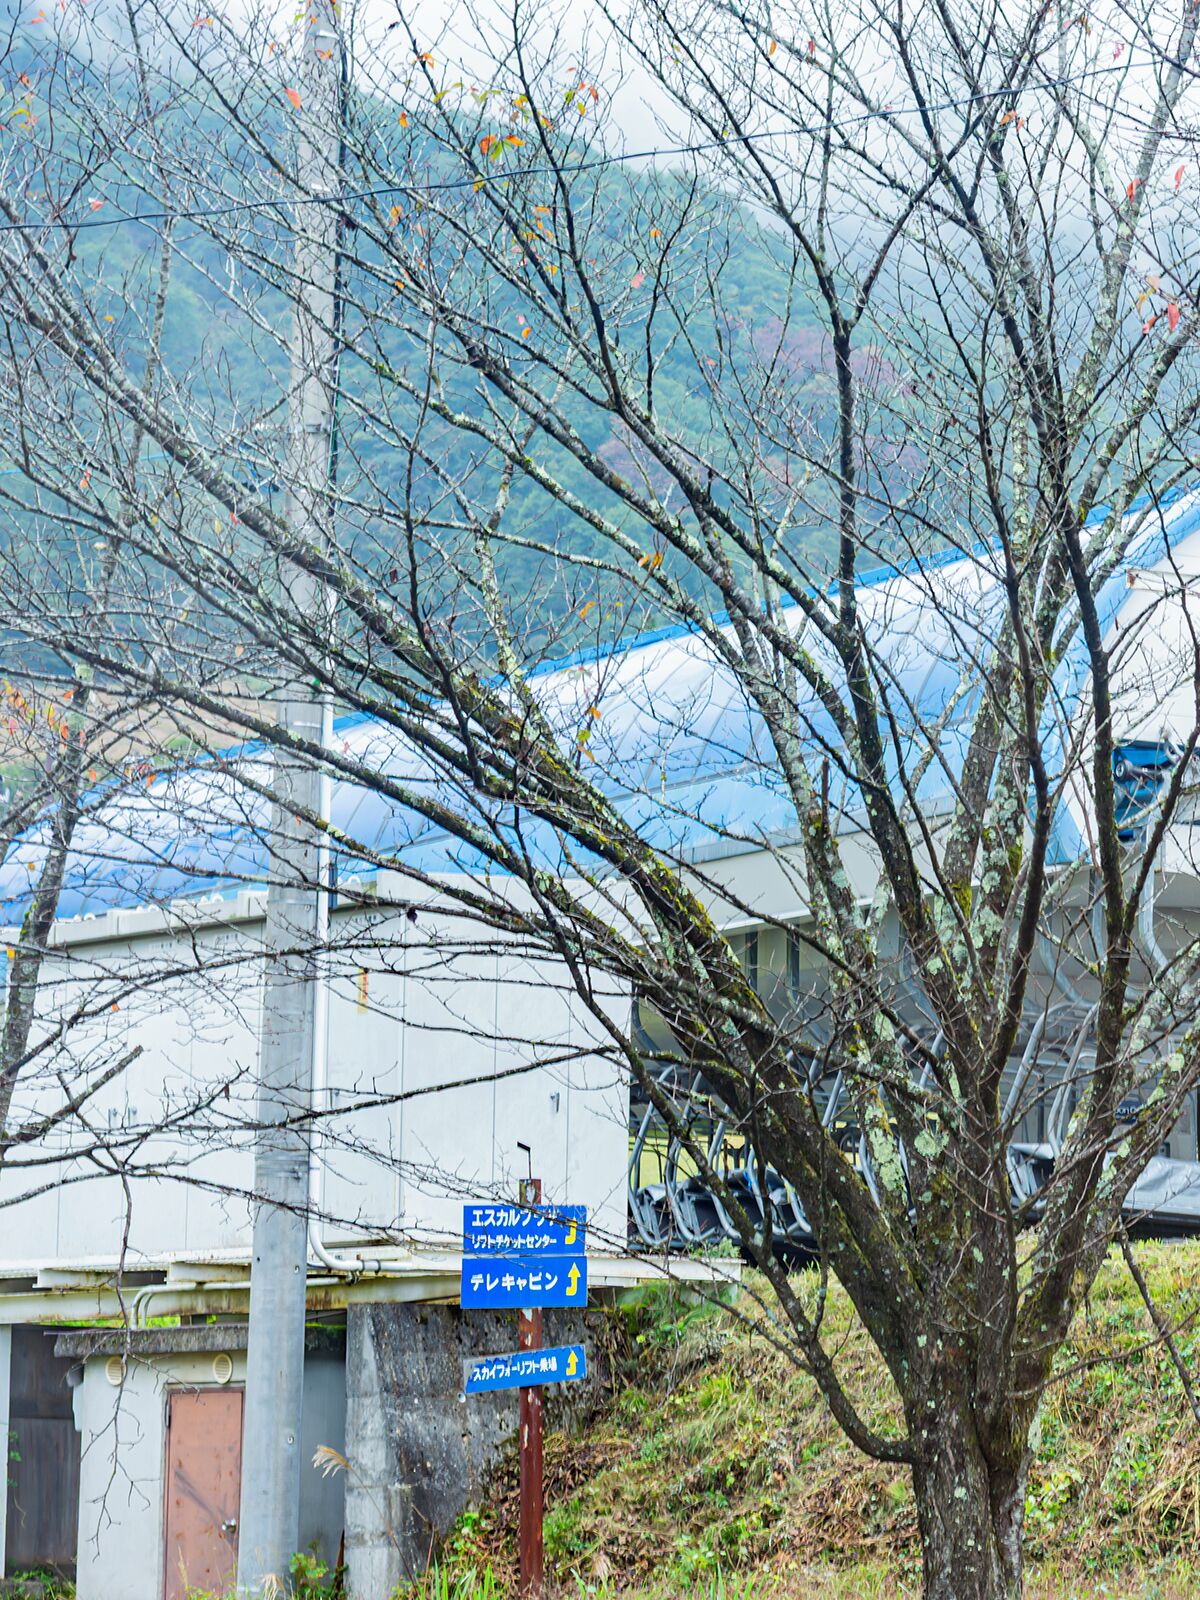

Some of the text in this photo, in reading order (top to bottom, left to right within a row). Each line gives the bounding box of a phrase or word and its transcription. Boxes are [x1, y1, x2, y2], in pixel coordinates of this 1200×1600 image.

[472, 1234, 557, 1249] リフトチケットセンター
[470, 1272, 558, 1291] テレキャビン
[473, 1356, 558, 1382] スカイフォーリフト乗場
